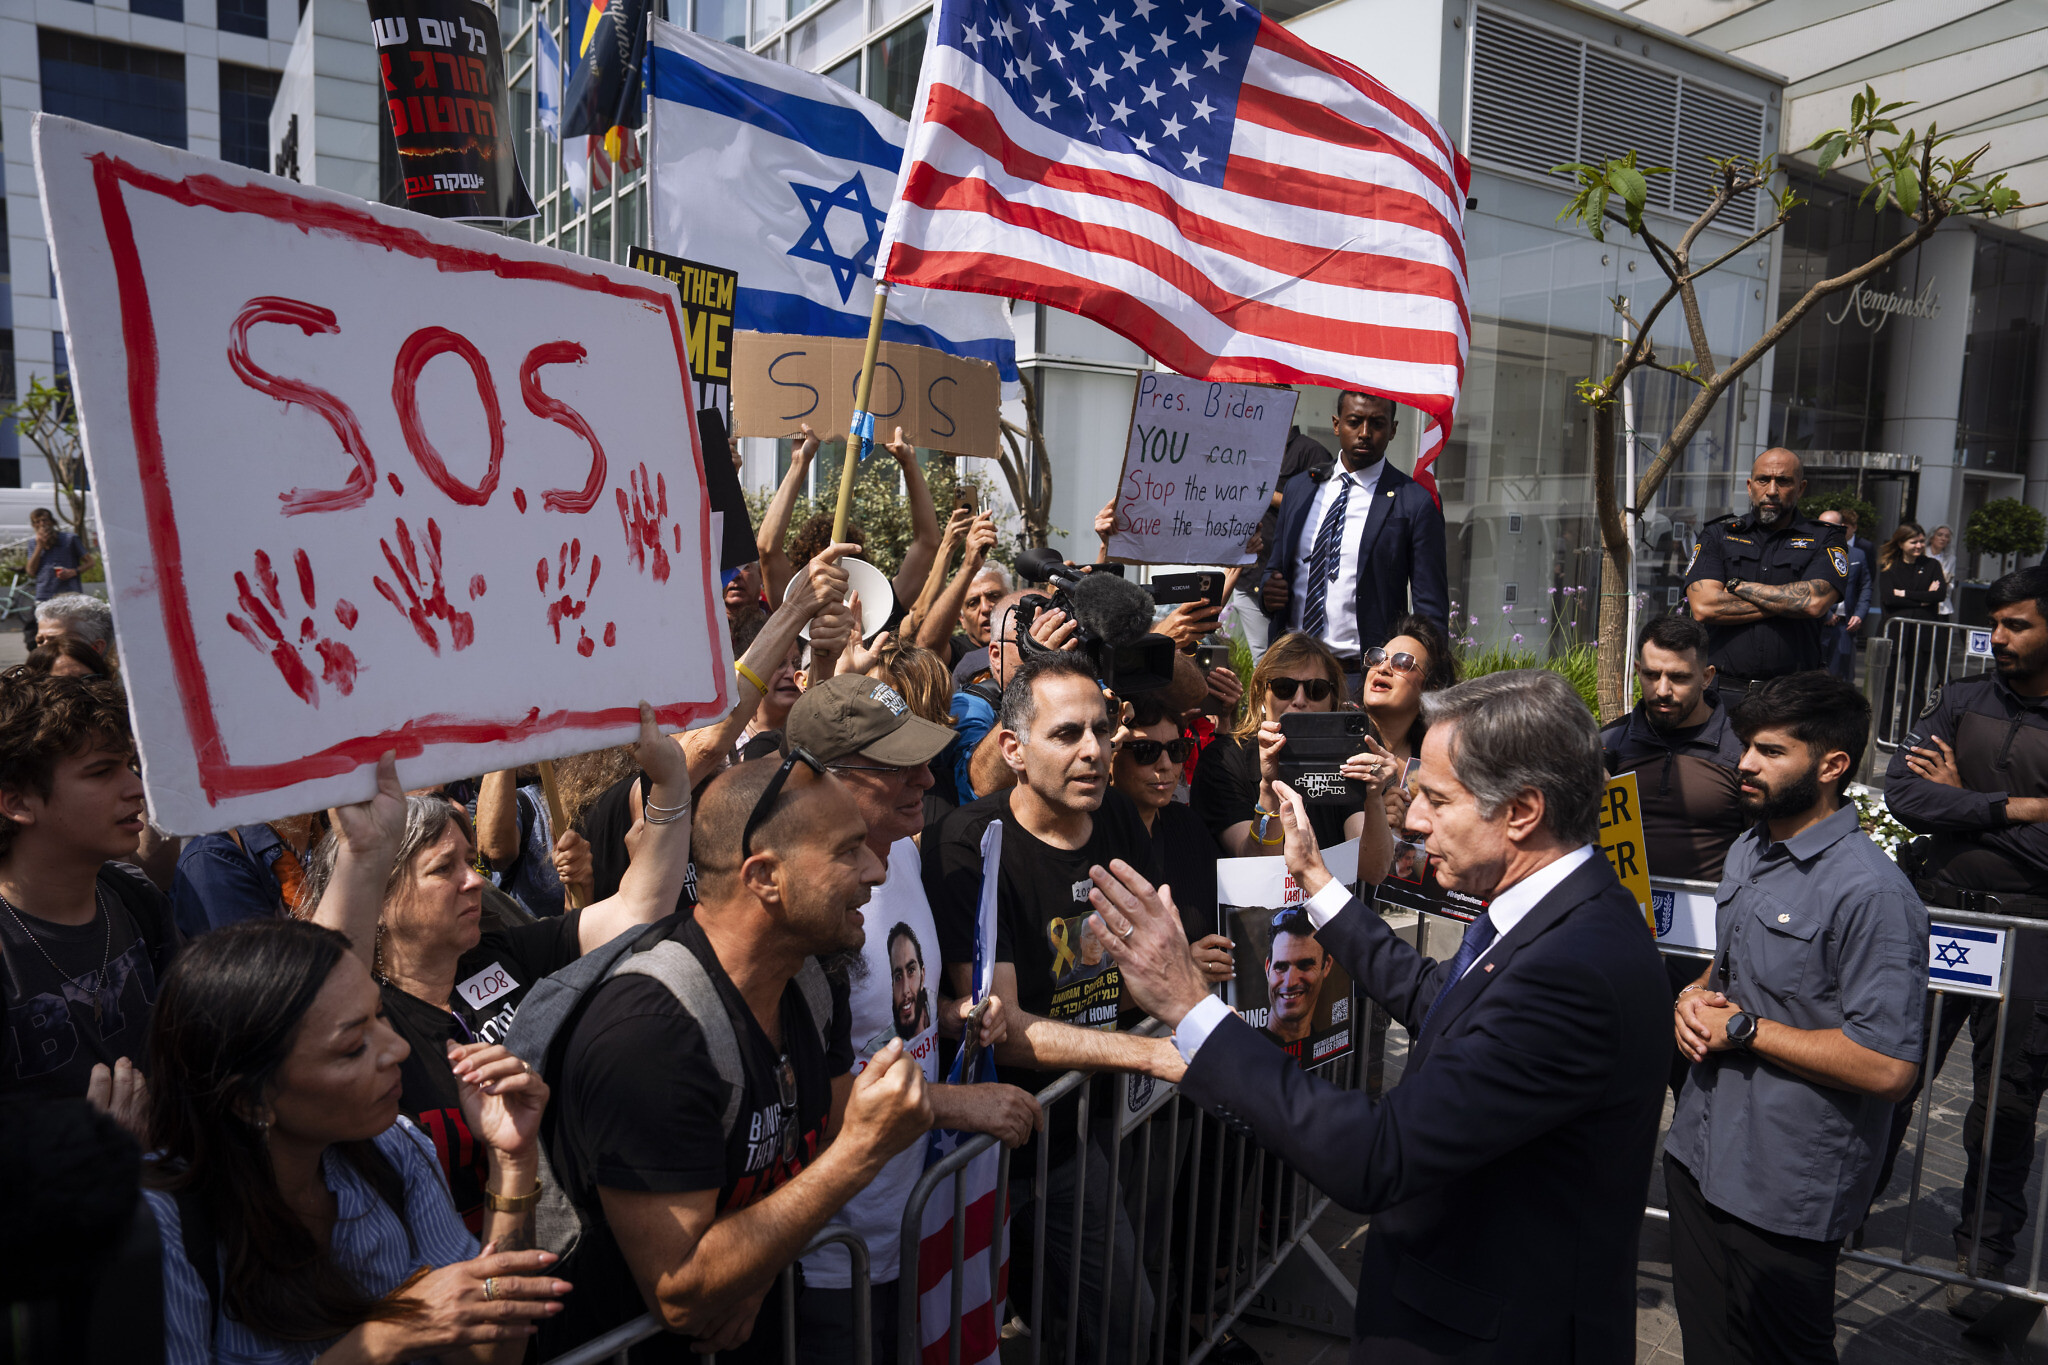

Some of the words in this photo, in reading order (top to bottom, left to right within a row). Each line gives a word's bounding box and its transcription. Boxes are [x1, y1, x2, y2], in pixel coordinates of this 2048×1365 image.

[418, 18, 456, 47] יום
[460, 17, 488, 55] כל
[409, 51, 488, 95] הורג
[682, 265, 735, 311] THEM
[1826, 276, 1941, 333] Kempinski
[1139, 376, 1190, 412] Pres.
[1204, 383, 1264, 421] Biden
[1137, 424, 1189, 464] YOU
[1208, 446, 1247, 465] can
[1125, 470, 1175, 506] Stop
[1185, 474, 1207, 501] the
[1215, 484, 1249, 502] war
[1117, 503, 1161, 535] Save
[1173, 510, 1192, 536] the
[1205, 510, 1256, 547] hostage
[469, 970, 509, 1000] 208
[1106, 971, 1119, 985] 85
[1089, 1003, 1118, 1023] HOME
